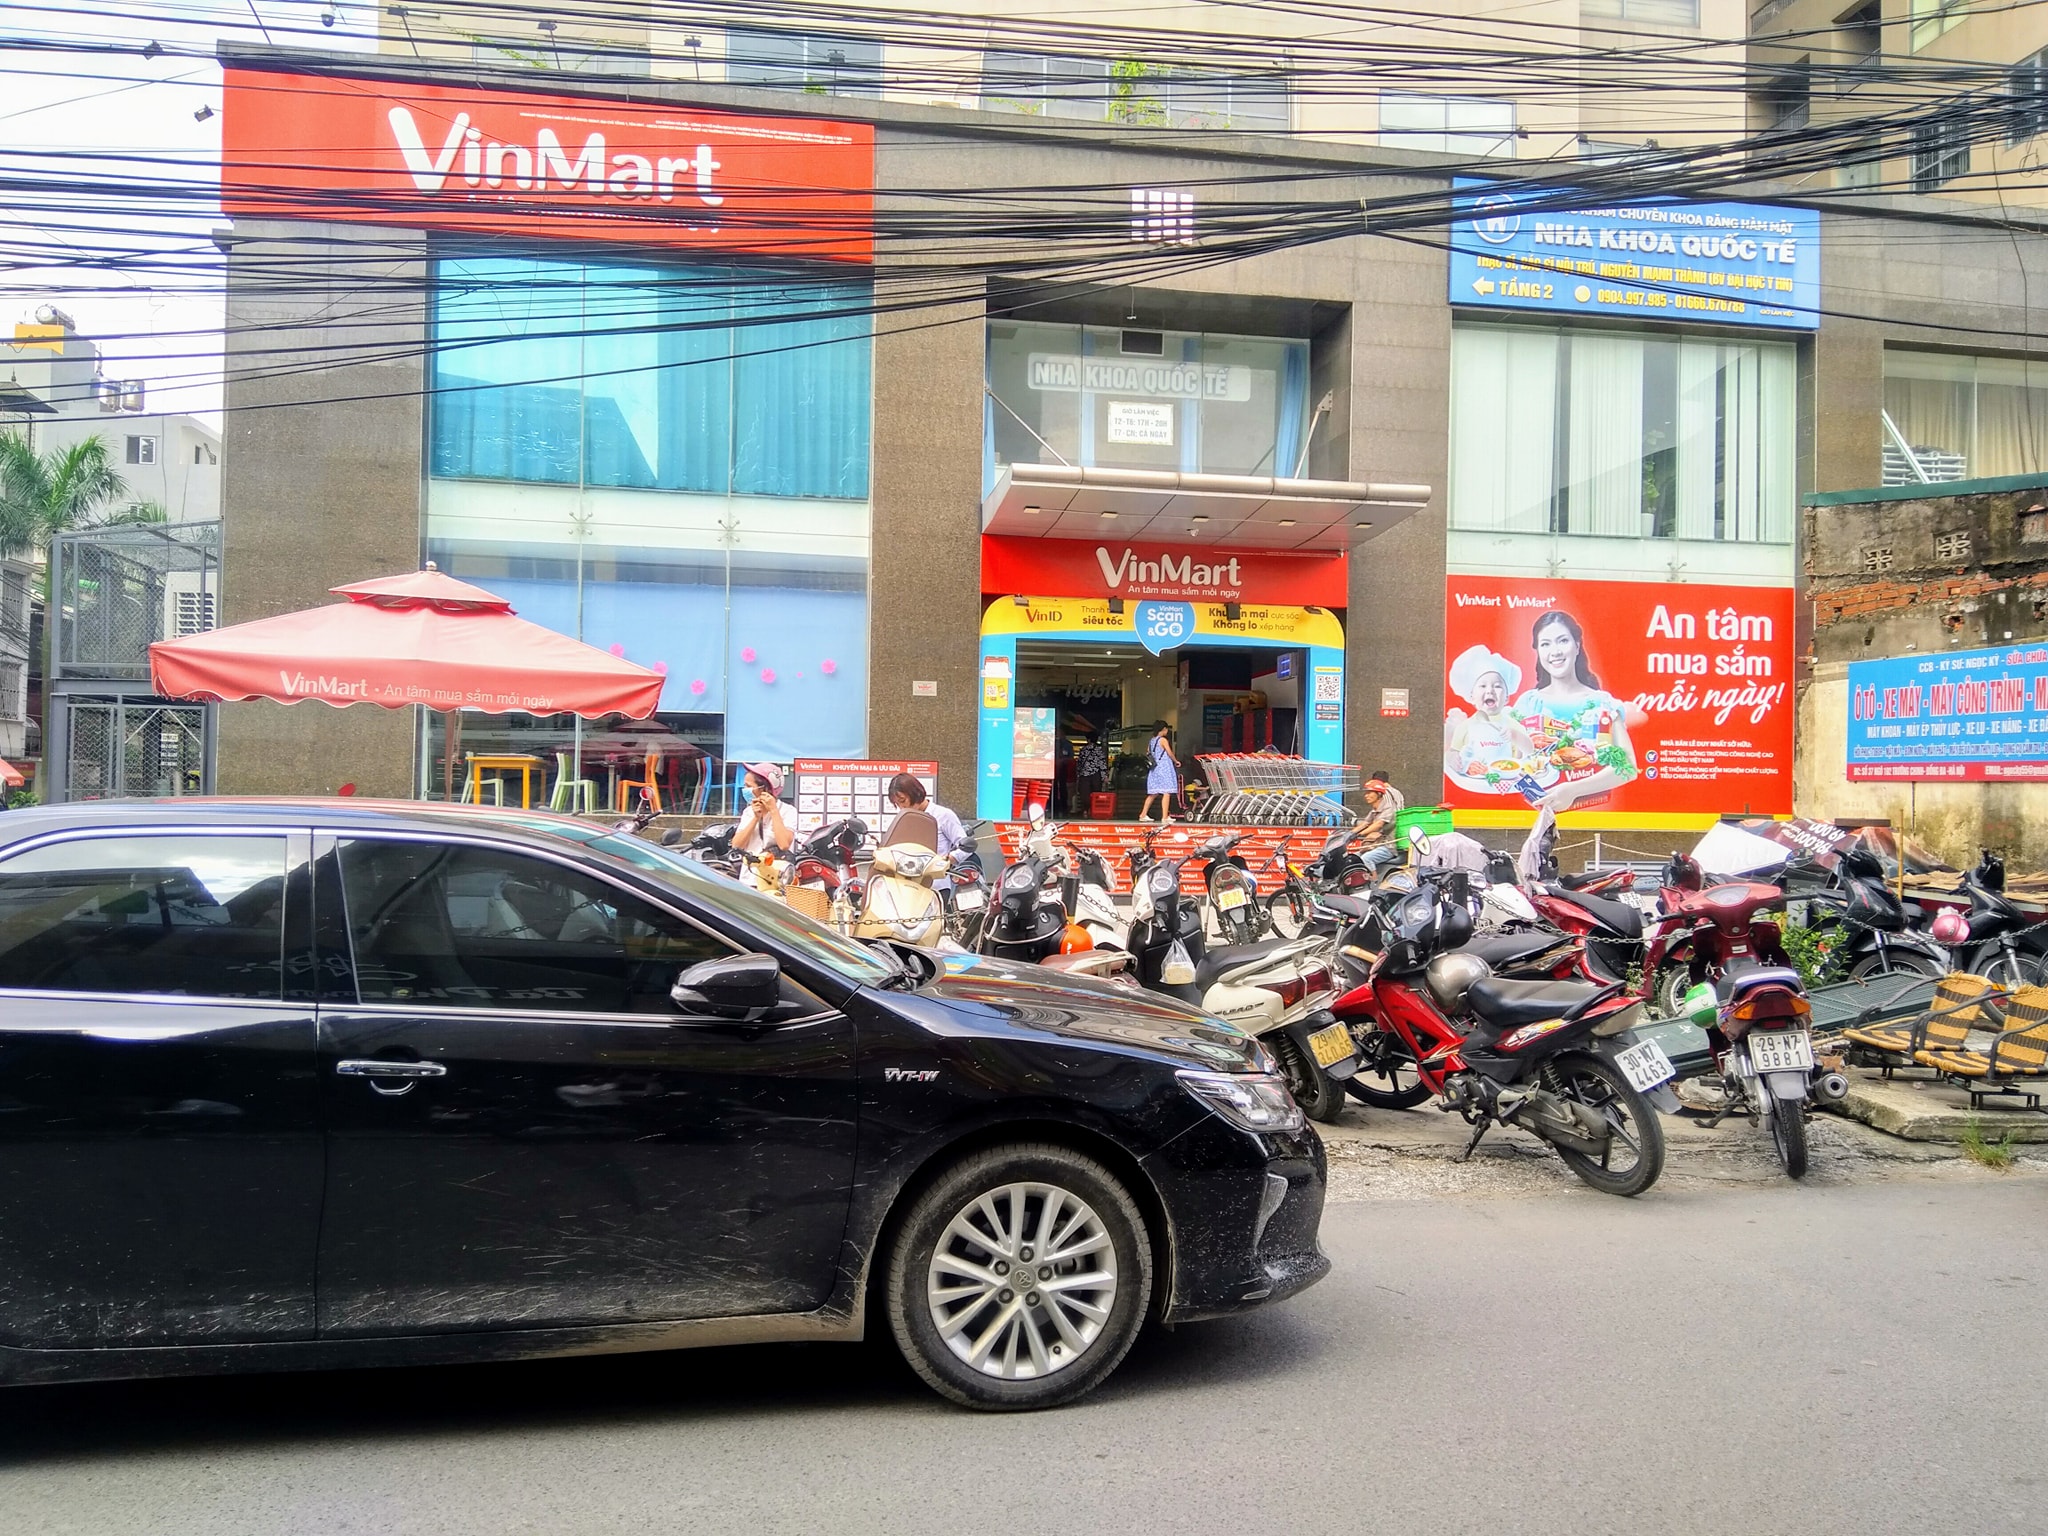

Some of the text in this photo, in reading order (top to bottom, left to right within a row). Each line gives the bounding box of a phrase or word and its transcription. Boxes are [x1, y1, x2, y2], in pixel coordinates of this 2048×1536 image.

[388, 107, 724, 206] VinMart
[1618, 207, 1667, 223] CHUYÊN
[1669, 212, 1703, 226] KHOA
[1706, 213, 1739, 229] RĂNG
[1741, 216, 1768, 231] HÀM
[1769, 219, 1795, 236] MẶT
[1535, 222, 1798, 264] NHA KHOA QUỐC TẾ
[1600, 259, 1639, 279] NGUYỄN
[1643, 266, 1673, 284] MẠNH
[1674, 267, 1707, 284] THÀNH
[1767, 277, 1775, 291] Y
[1499, 276, 1541, 299] TẦNG
[1543, 284, 1554, 299] 2
[1597, 289, 1667, 307] 0904.997.985
[1034, 362, 1230, 396] NHA KHOA QUỐC TẾ
[1095, 546, 1242, 588] VinMart
[1128, 584, 1240, 599] An tâm mua sắm mỗi ngày
[1455, 593, 1501, 607] VinMart
[1025, 608, 1063, 623] VinID
[1081, 605, 1105, 613] Thanh
[1147, 608, 1183, 622] Scan
[1208, 607, 1247, 618] Khun
[1249, 609, 1269, 621] mại
[1082, 615, 1123, 625] siêu tốc
[1213, 617, 1294, 633] Không lo xếp hàng
[1646, 604, 1773, 641] An tâm
[1647, 645, 1772, 676] mua sắm
[280, 670, 554, 710] VinMart An tâm mua sắm mỗi ngày
[1854, 671, 2025, 721] Ô TÔ XE MÁY MÁY CÔNG TRÌNH
[1633, 679, 1787, 725] mỗi ngày!
[1966, 721, 1976, 735] XE
[1991, 720, 2001, 734] XE
[1565, 768, 1595, 782] VinMart
[1163, 848, 1184, 856] VinMart
[1236, 849, 1257, 857] VinMart
[1318, 1040, 1352, 1066] 340.65
[1759, 1035, 1798, 1052] 29-N7
[1762, 1051, 1802, 1067] 9881
[1635, 1060, 1668, 1087] 4463
